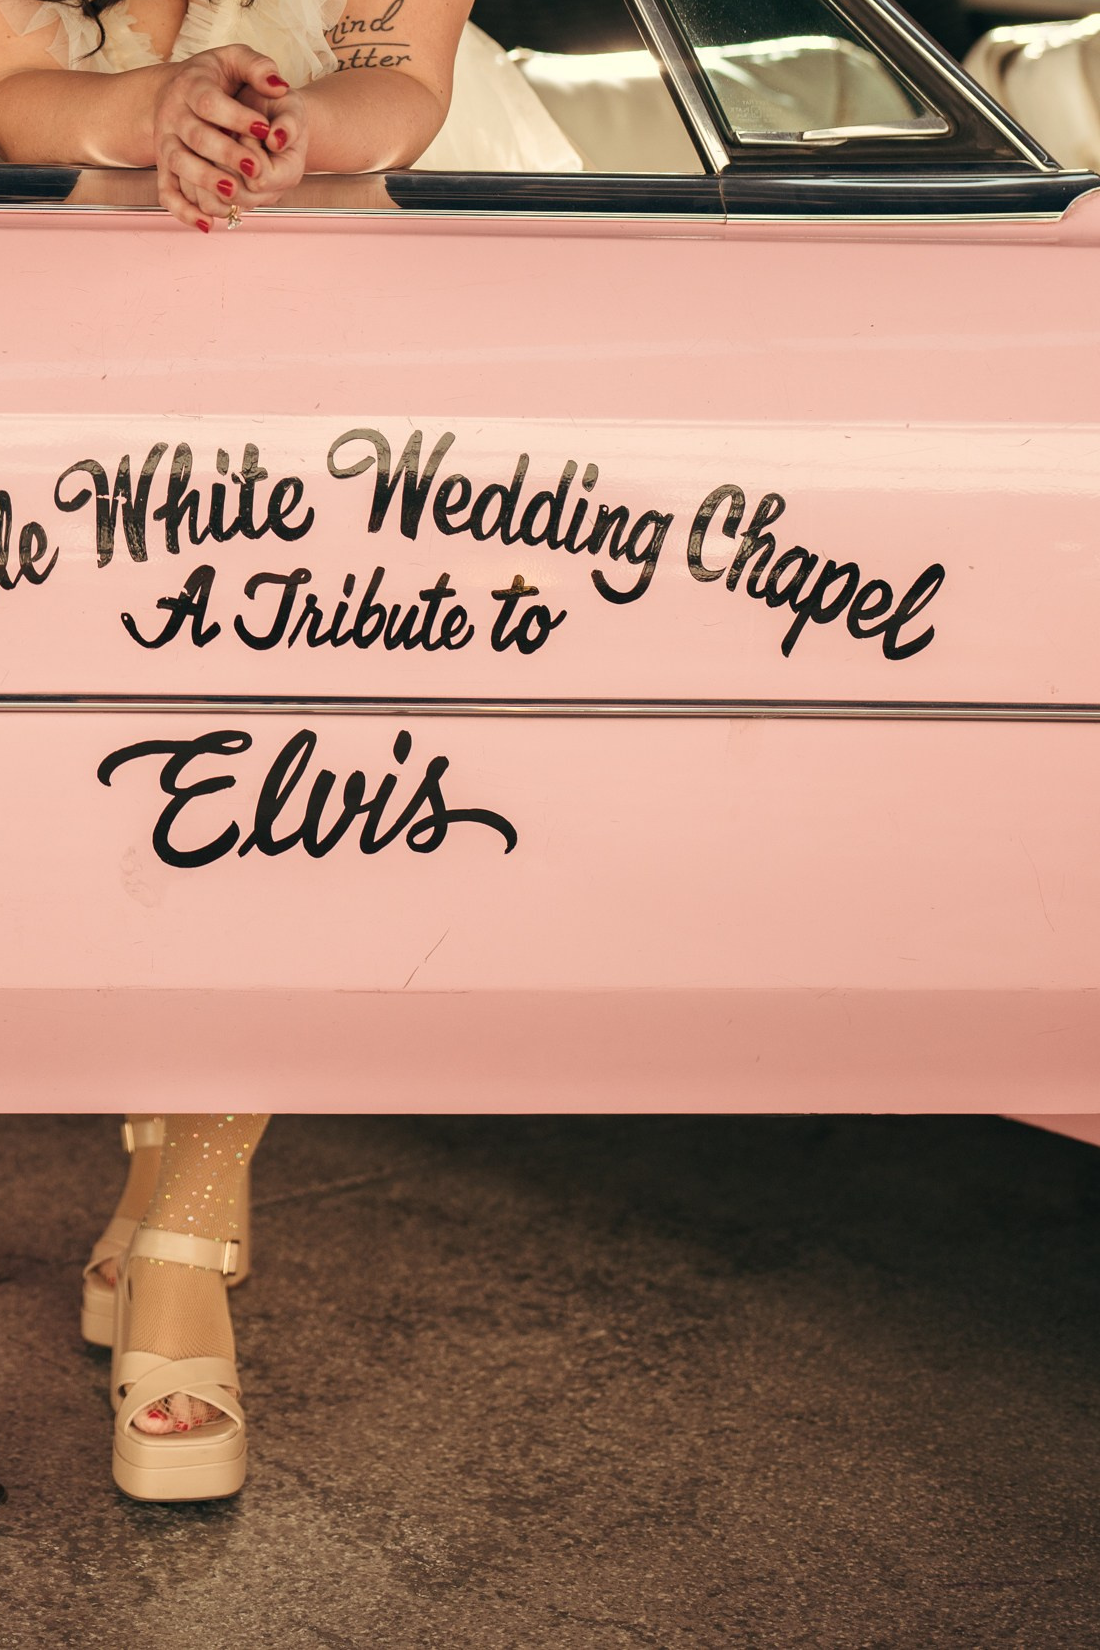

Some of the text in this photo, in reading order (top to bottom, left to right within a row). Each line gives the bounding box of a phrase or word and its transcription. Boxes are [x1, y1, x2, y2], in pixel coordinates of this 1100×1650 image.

[53, 440, 315, 569] White
[326, 426, 676, 605] Wedding
[686, 483, 946, 661] Chapel
[120, 563, 568, 656] A Tribute to
[96, 728, 518, 869] Elvis
